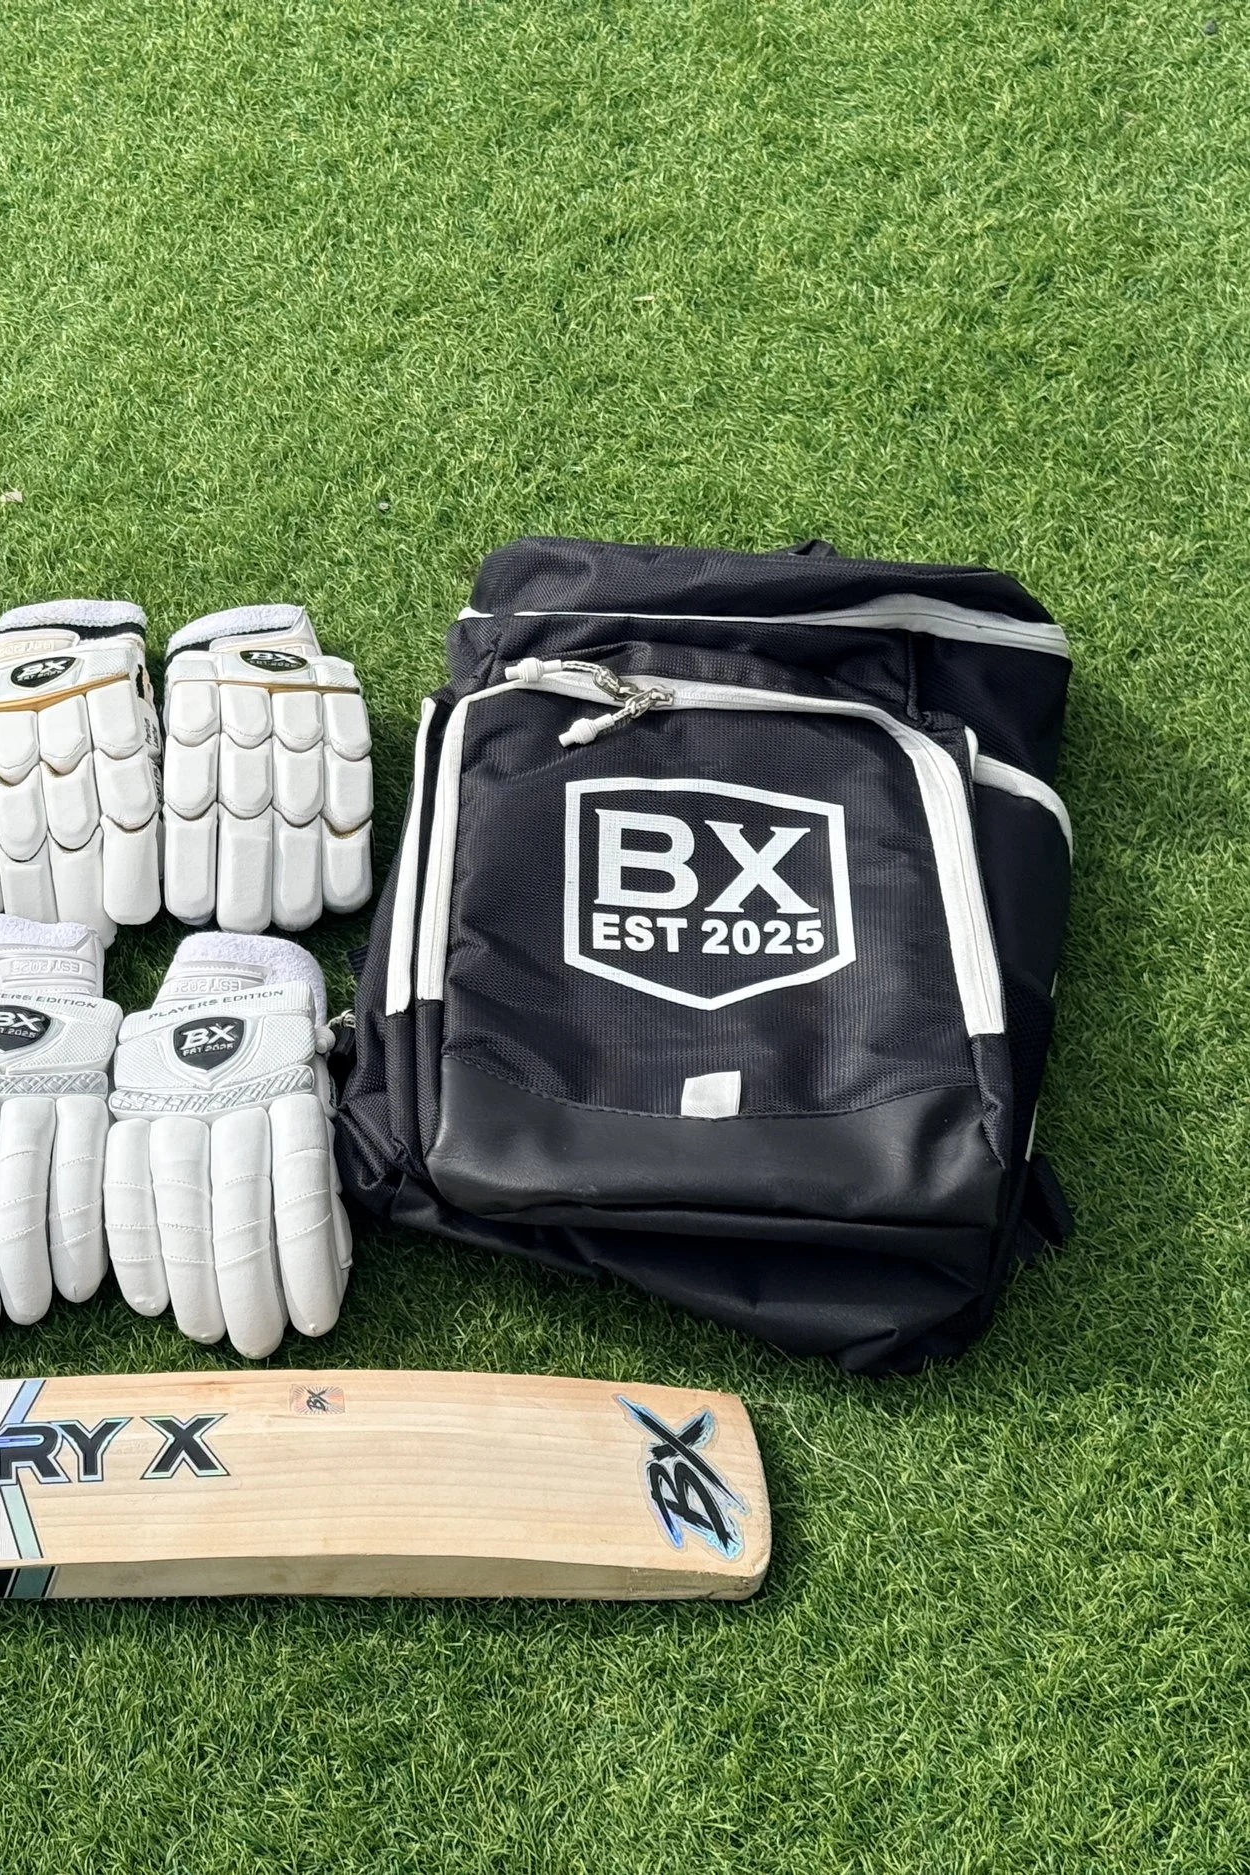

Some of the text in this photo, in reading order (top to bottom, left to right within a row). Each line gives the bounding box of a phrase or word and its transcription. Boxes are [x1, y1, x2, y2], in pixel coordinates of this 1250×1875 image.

[16, 661, 67, 680] BX
[249, 652, 299, 664] BX
[594, 808, 819, 913] BX
[592, 912, 825, 955] EST 2025
[36, 996, 98, 1009] EDITION
[149, 990, 284, 1020] PLAYERS EDITION
[179, 1023, 238, 1050] BX
[140, 1413, 232, 1481] X
